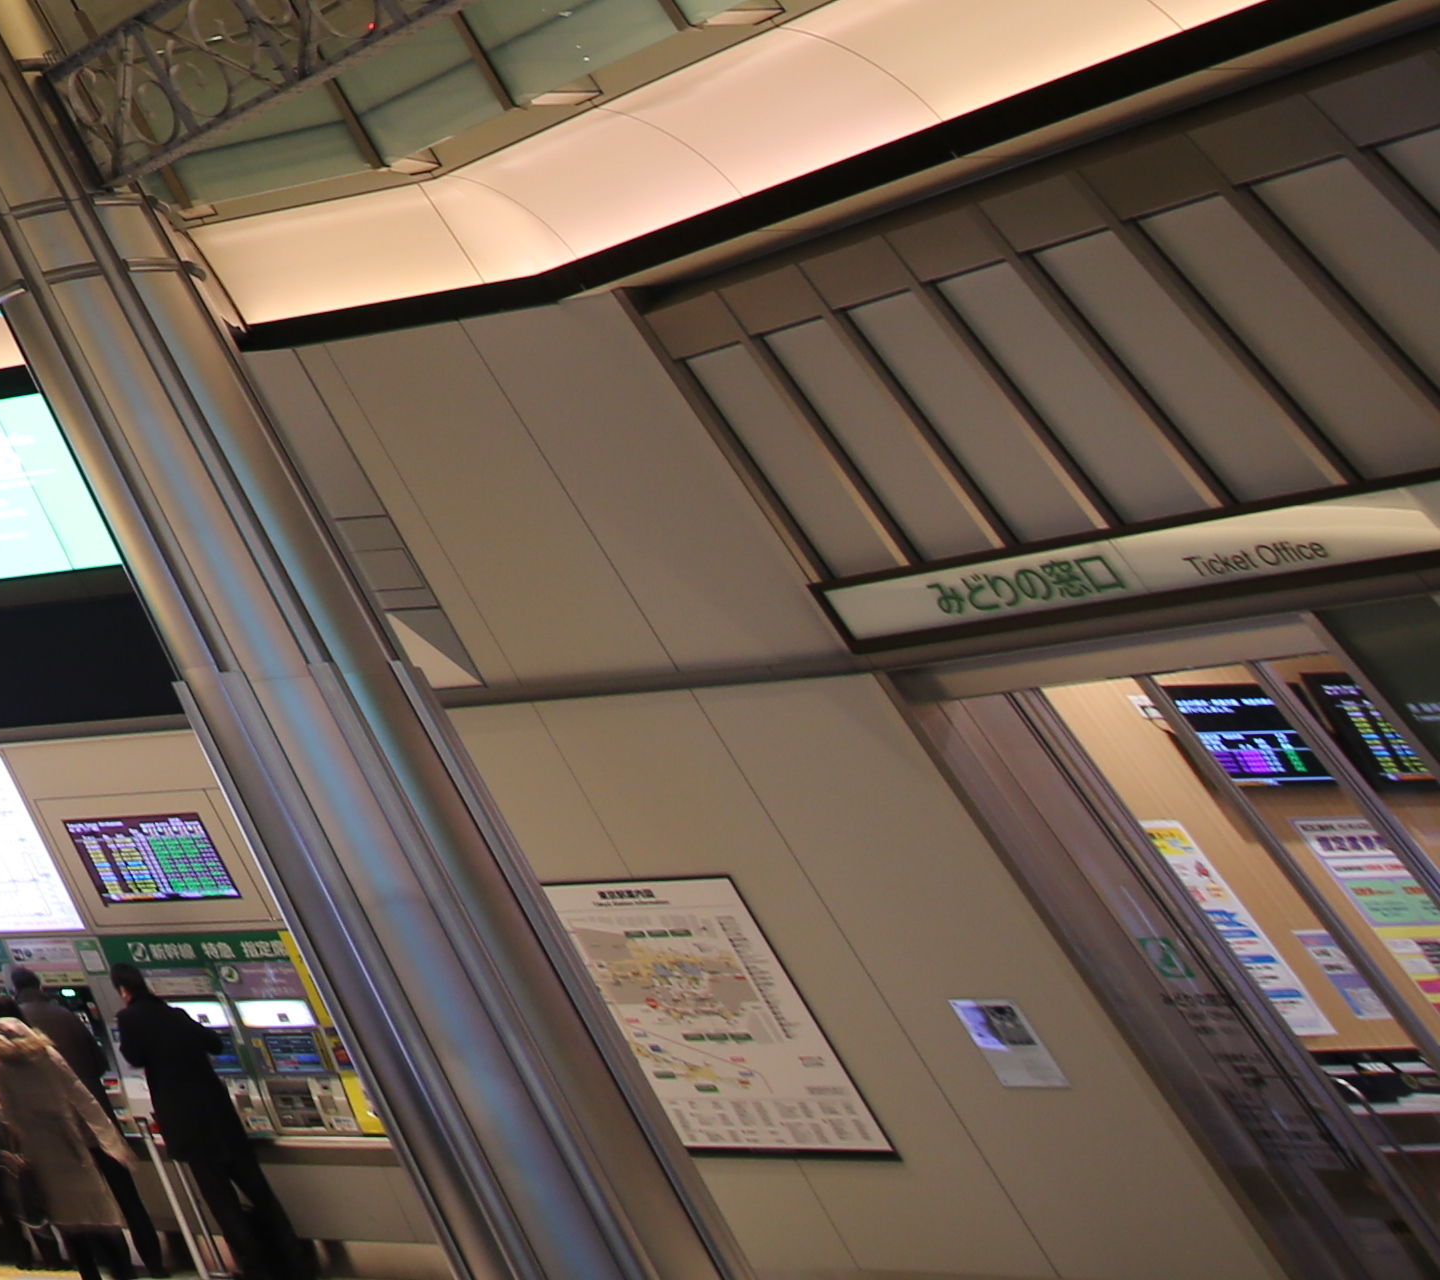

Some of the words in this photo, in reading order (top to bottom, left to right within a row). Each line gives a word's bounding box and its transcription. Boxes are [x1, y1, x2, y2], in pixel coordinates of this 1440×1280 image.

[1182, 549, 1259, 577] Ticket
[1254, 541, 1329, 566] Office
[927, 555, 1126, 615] みどりの窓口
[148, 943, 197, 961] 新幹線
[200, 942, 236, 959] 特急
